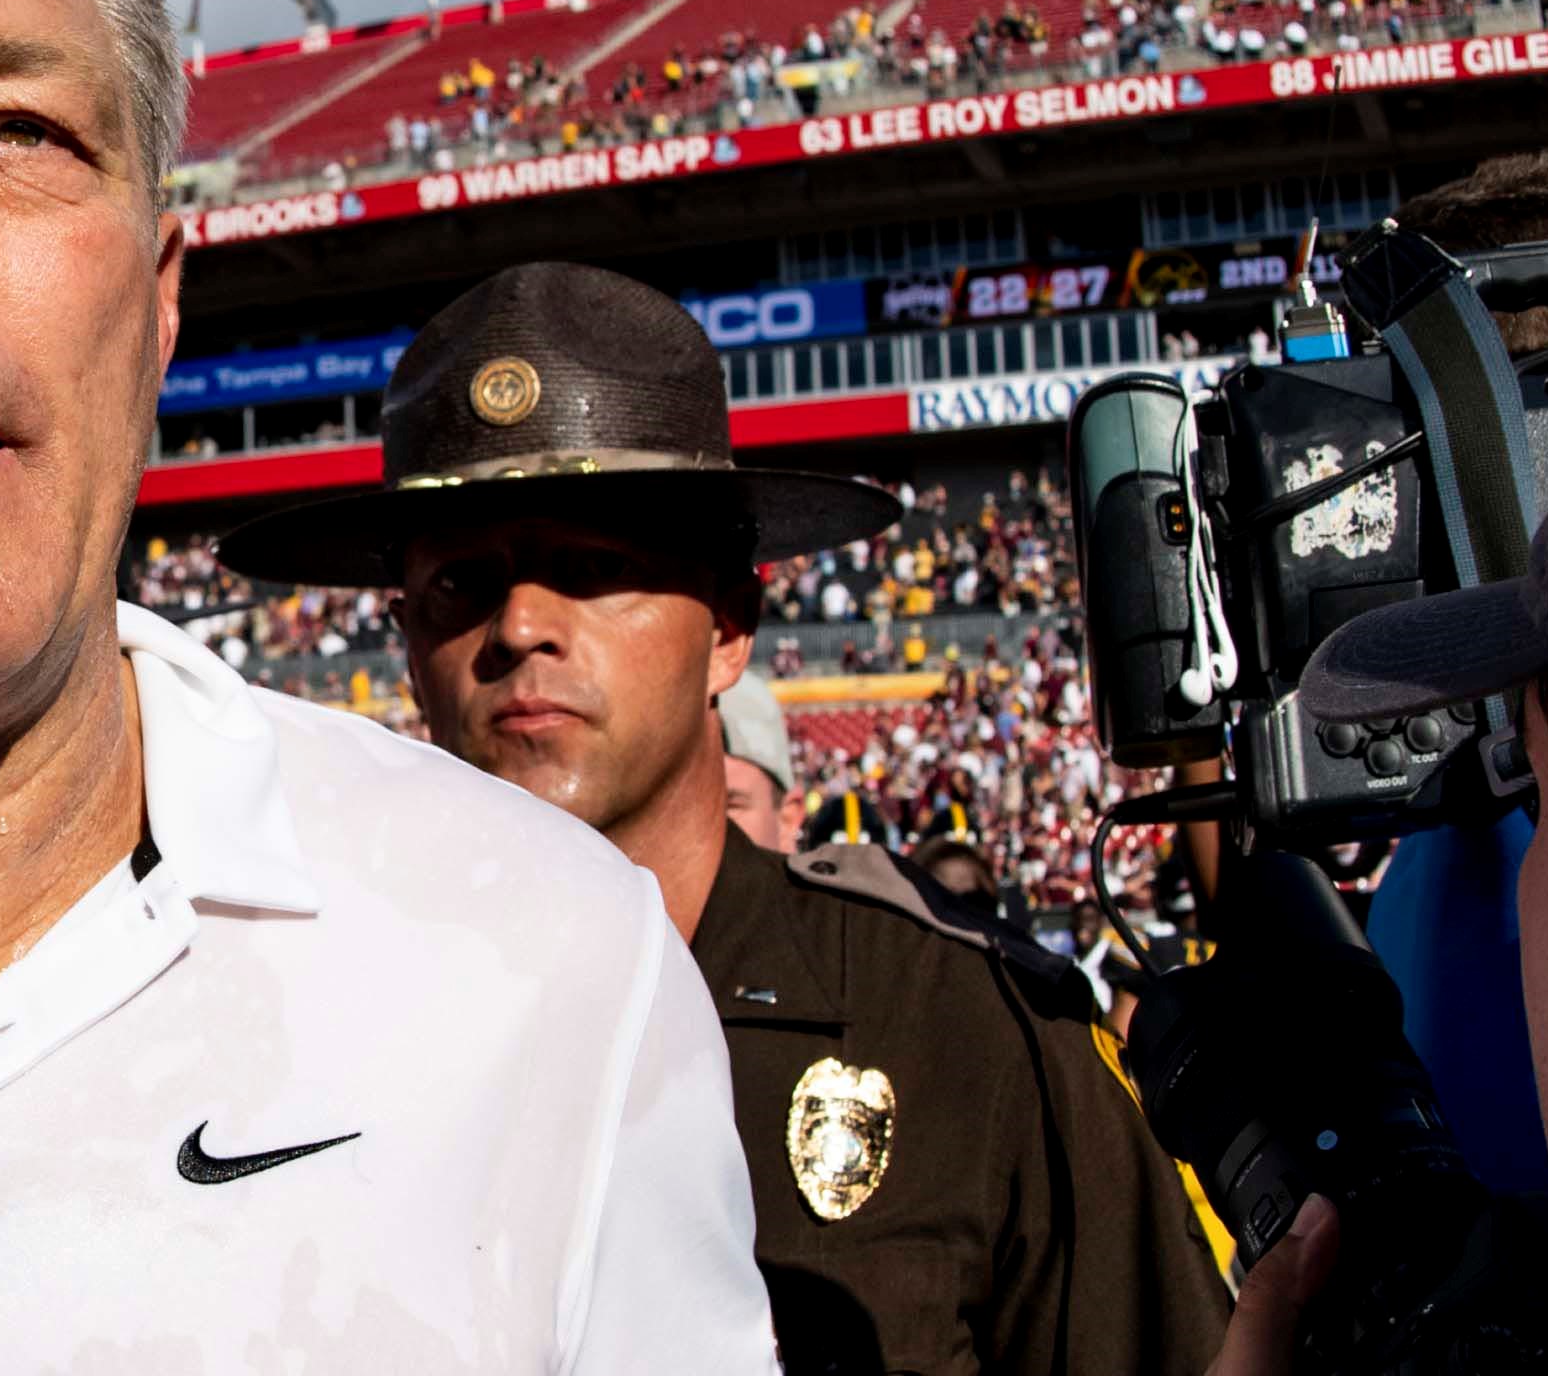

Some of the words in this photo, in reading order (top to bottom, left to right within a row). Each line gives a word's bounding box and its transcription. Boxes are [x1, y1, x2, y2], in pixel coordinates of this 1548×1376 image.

[1269, 57, 1317, 98] 88
[1322, 42, 1458, 93] JIMMIE
[799, 117, 844, 155] 63
[849, 106, 923, 150] LEE
[927, 95, 1010, 138] ROY
[1014, 74, 1176, 127] SELMON
[417, 173, 459, 211] 99
[461, 152, 609, 202] WARREN
[613, 134, 711, 181] SAPP
[205, 192, 340, 242] BROOKS
[966, 273, 1030, 318] 22
[1049, 265, 1111, 309] 27
[1218, 255, 1288, 290] 2ND
[692, 290, 815, 343] ICO
[215, 362, 309, 393] Tampa
[316, 352, 374, 382] Bay
[914, 377, 1084, 430] RAYMO
[1391, 774, 1408, 787] OUT
